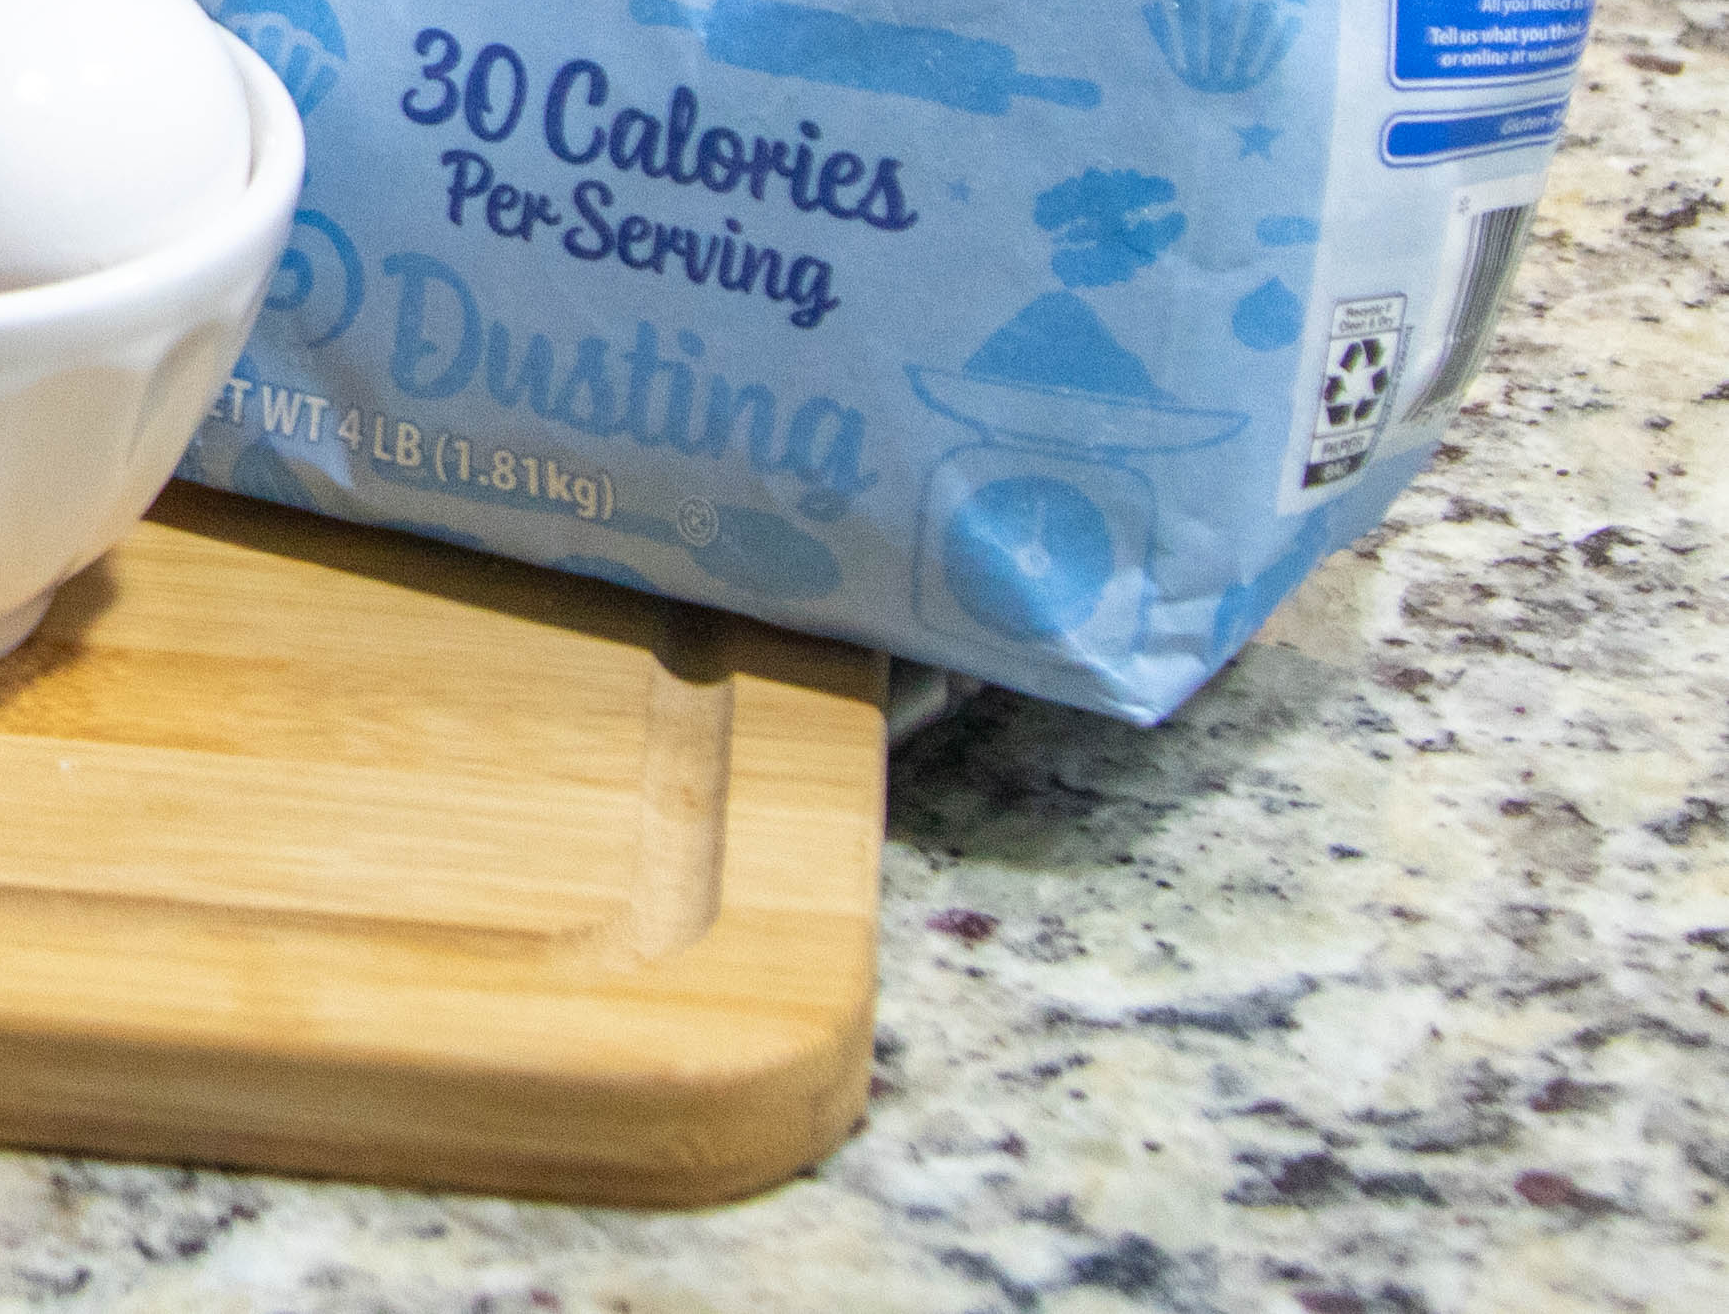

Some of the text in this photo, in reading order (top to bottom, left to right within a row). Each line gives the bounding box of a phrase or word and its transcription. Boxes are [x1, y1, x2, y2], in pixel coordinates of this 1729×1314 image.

[1427, 26, 1547, 45] Tell us what you
[1460, 50, 1509, 65] online
[1503, 0, 1529, 16] you
[400, 26, 921, 231] 30 Calories
[441, 148, 843, 330] Per Serving
[381, 250, 879, 524] Dusting
[262, 388, 330, 445] WT
[337, 409, 365, 452] 4
[372, 420, 425, 469] LB
[434, 434, 618, 522] (1.81kg)
